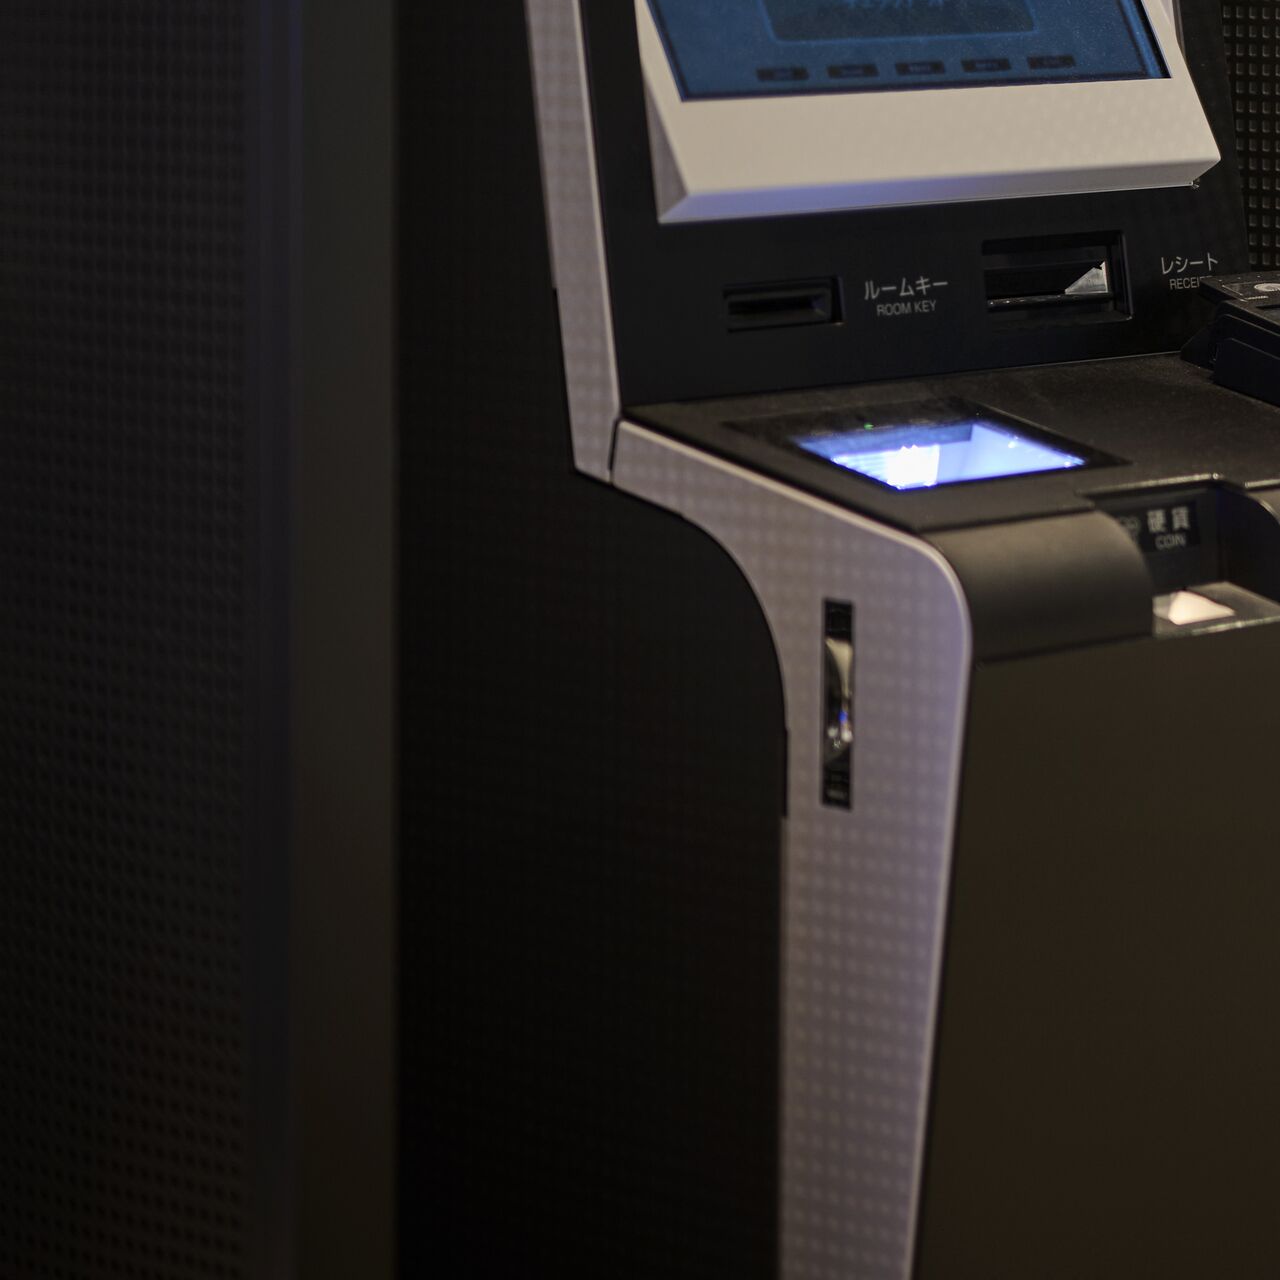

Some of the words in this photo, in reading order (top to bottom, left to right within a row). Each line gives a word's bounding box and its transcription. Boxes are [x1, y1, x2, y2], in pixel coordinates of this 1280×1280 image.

[1161, 252, 1218, 275] レシート
[864, 276, 949, 300] ルームキー
[1169, 275, 1213, 290] RECEI
[876, 303, 912, 316] ROOM
[914, 300, 937, 313] KEY
[1155, 533, 1187, 550] COIN
